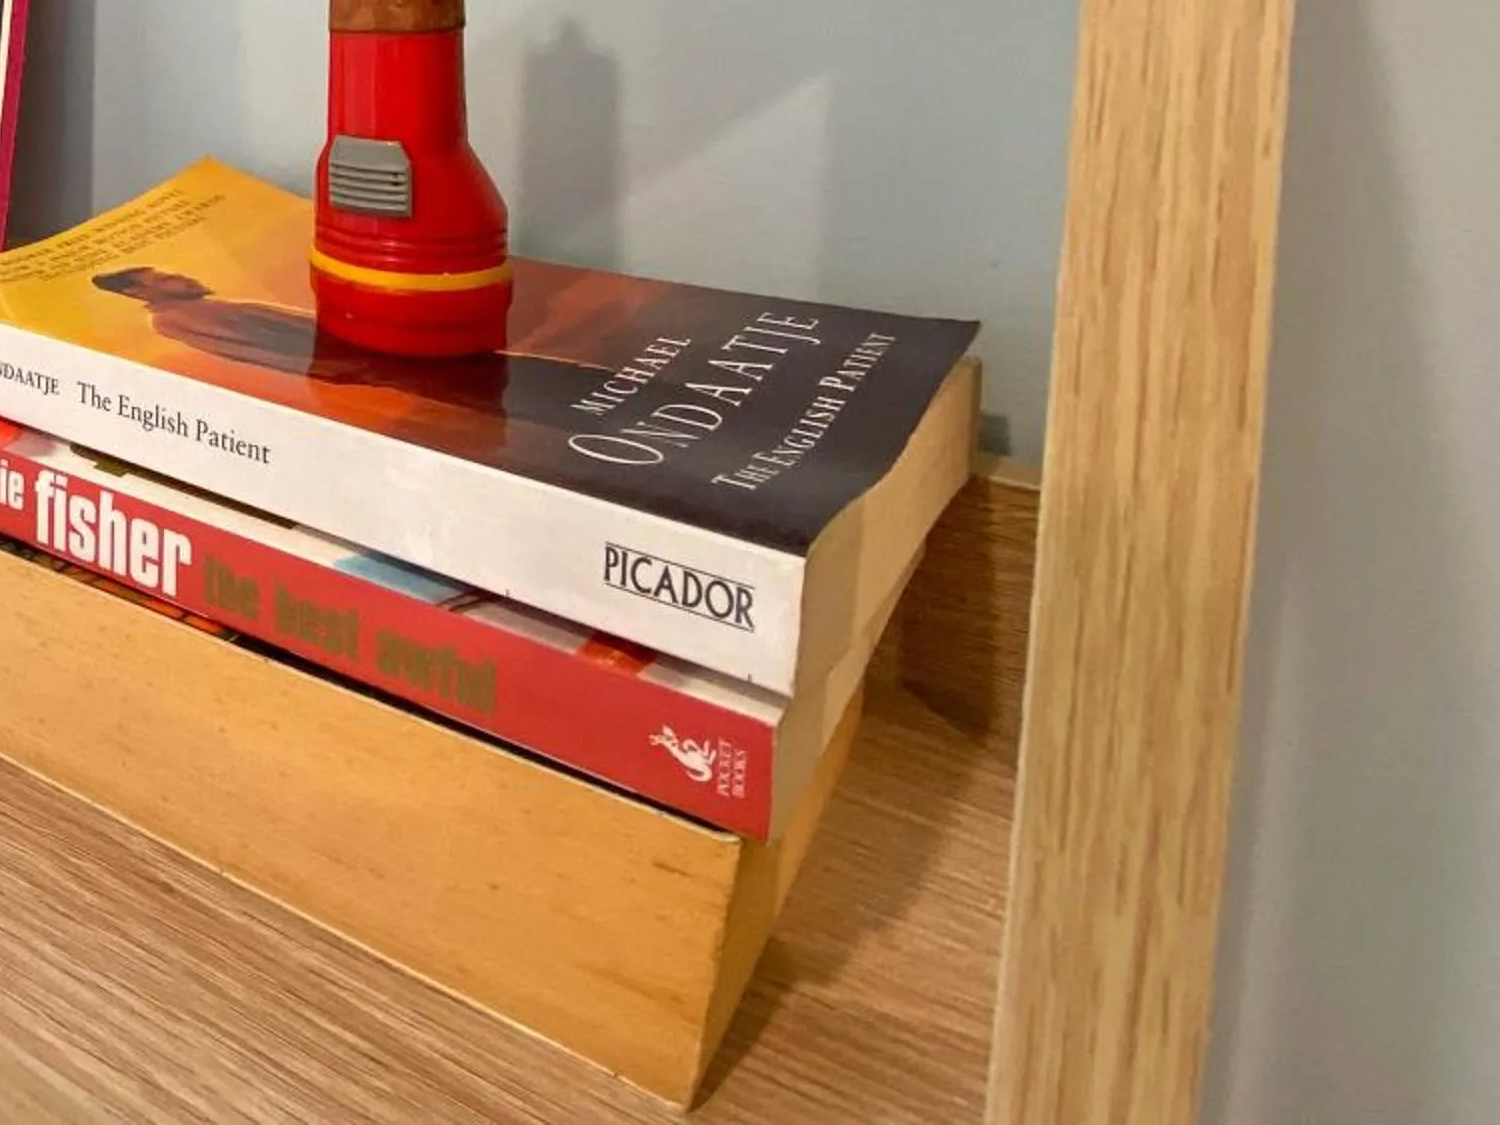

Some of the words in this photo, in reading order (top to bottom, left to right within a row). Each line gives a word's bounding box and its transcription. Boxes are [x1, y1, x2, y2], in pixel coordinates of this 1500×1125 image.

[76, 380, 112, 412] The
[117, 394, 189, 439] English
[195, 418, 271, 464] Patient
[568, 312, 821, 464] ONDAATJE
[570, 335, 692, 415] MICHAEL
[711, 465, 779, 490] THE
[752, 396, 846, 467] ENGLISH
[819, 332, 896, 392] PATIENT
[34, 469, 193, 598] fisher
[603, 545, 755, 629] PICADOR
